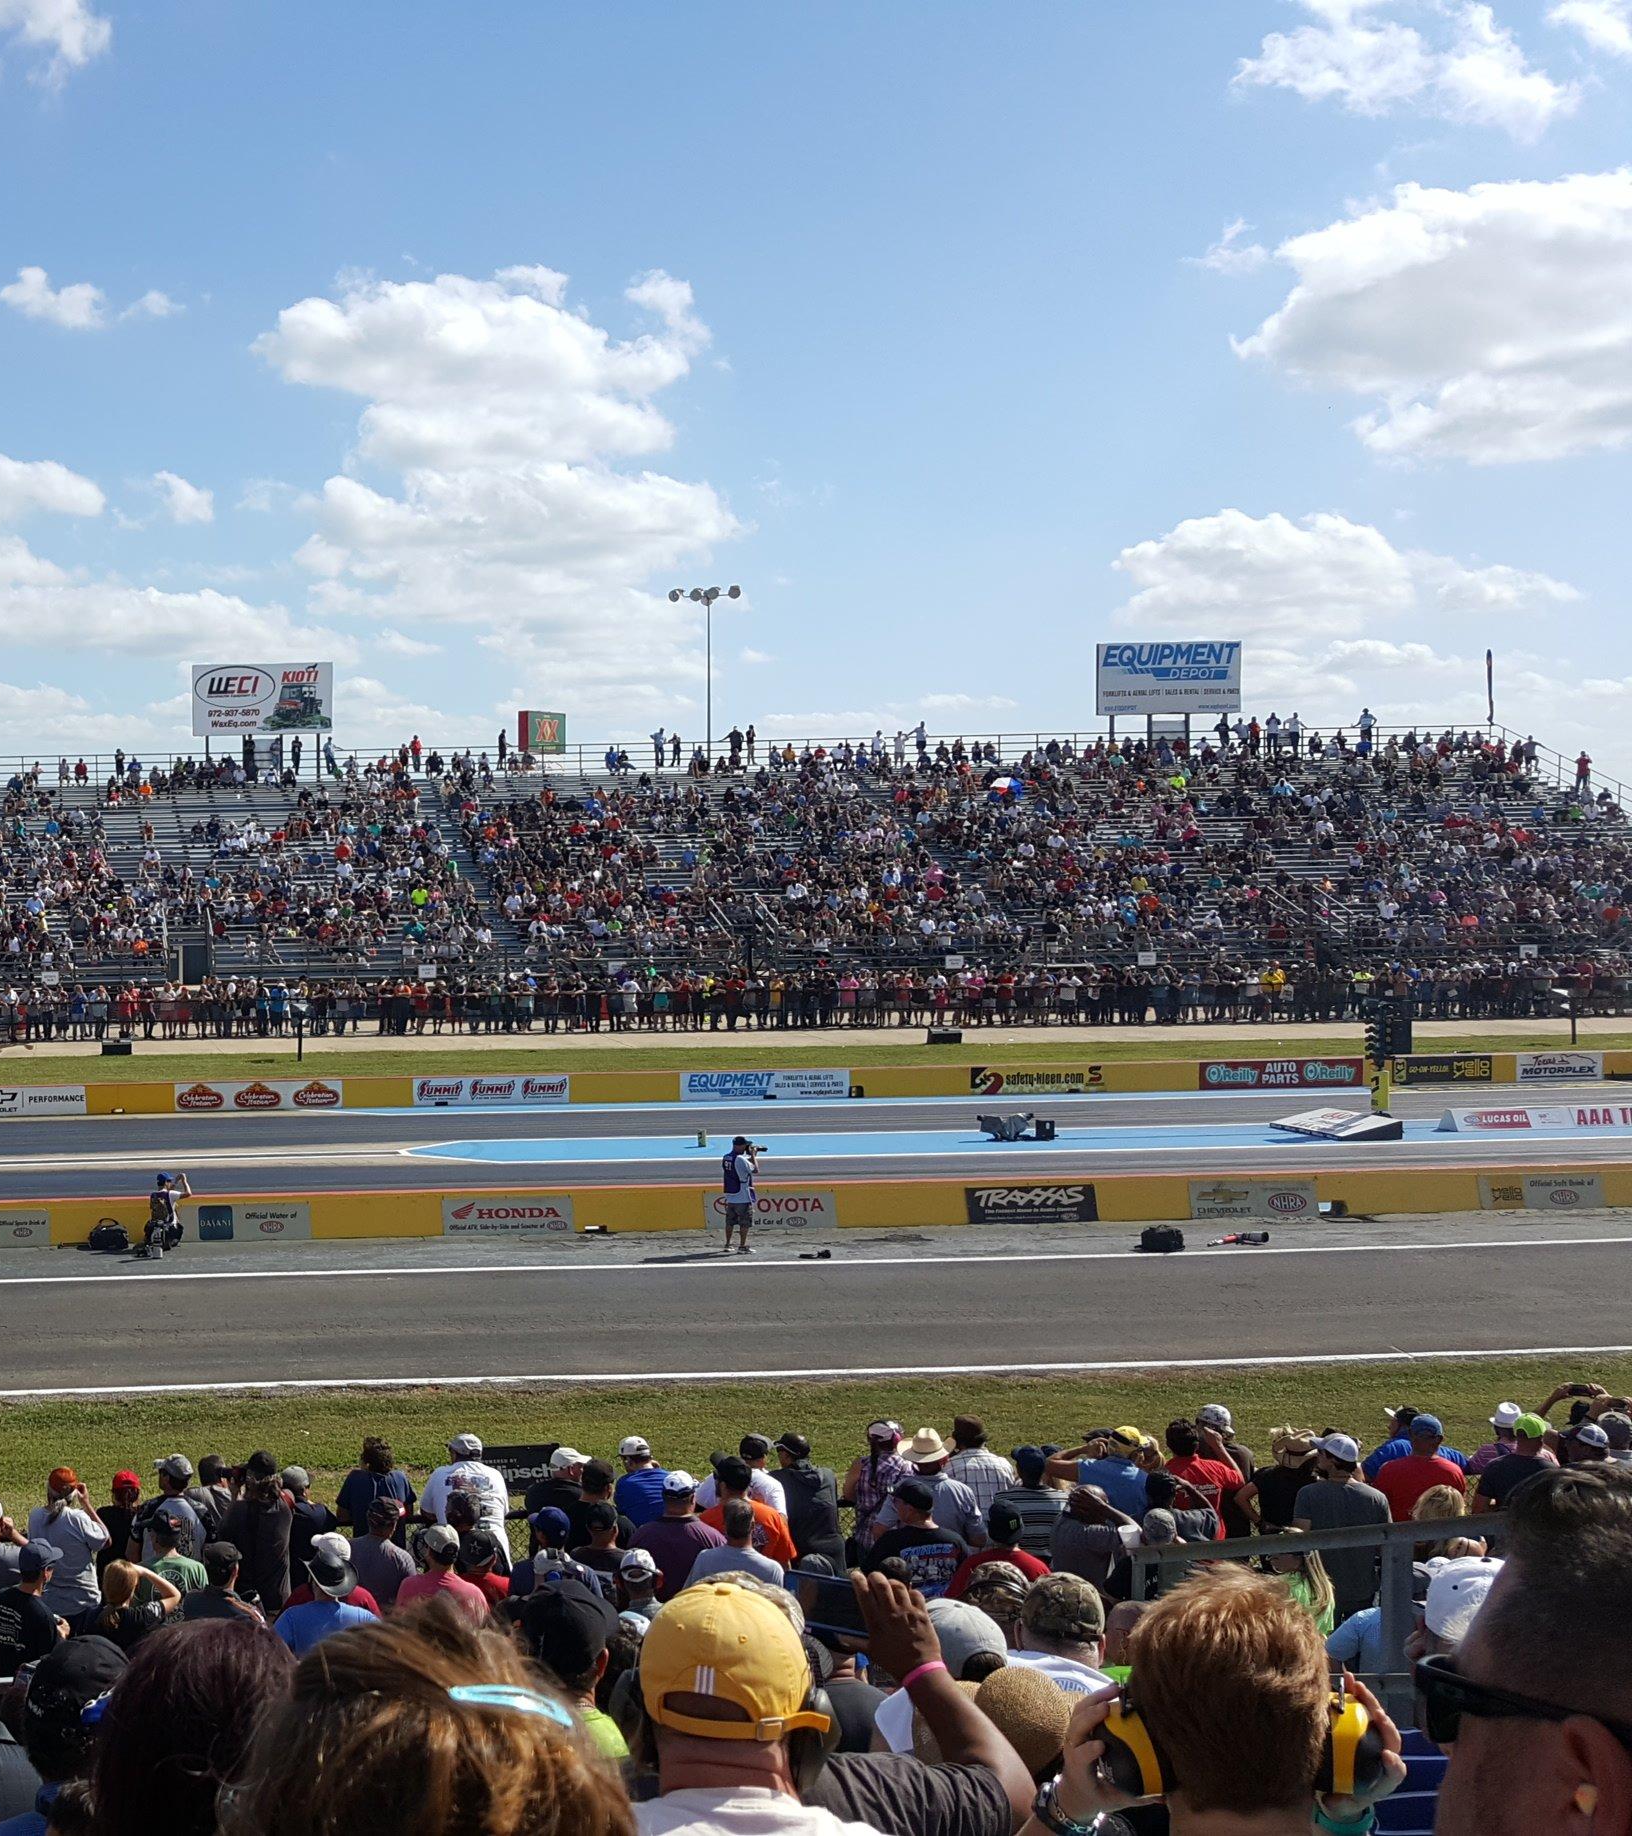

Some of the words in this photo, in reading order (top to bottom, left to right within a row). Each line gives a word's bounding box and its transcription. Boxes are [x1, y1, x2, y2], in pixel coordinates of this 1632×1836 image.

[1102, 643, 1239, 671] EQUIPMENT
[281, 671, 319, 682] KIOTI
[1169, 668, 1215, 679] DEPOT
[207, 676, 259, 695] WECI
[208, 709, 260, 717] 972-937-5870
[211, 720, 257, 728] WaxEq.com
[536, 719, 559, 742] XX
[1265, 1062, 1297, 1072] AUTO
[1533, 1055, 1556, 1067] Texas
[1206, 1064, 1258, 1084] O'Reilly
[1304, 1062, 1355, 1081] O'Reilly
[1522, 1066, 1595, 1075] MOTORPLEX
[688, 1073, 775, 1088] EQUIPMENT
[1006, 1072, 1084, 1086] safety-kleen.com
[1262, 1073, 1299, 1084] PARTS
[28, 1094, 85, 1103] PERFORMANCE
[298, 1091, 333, 1099] Celebration
[1482, 1114, 1511, 1123] LUCAS
[1513, 1113, 1528, 1121] OIL
[1577, 1108, 1614, 1125] AAA
[974, 1187, 1085, 1207] TRAXXAS
[1273, 1196, 1302, 1209] NHRA
[757, 1198, 824, 1212] OYOTA
[1197, 1206, 1253, 1214] CHEVROLET
[476, 1207, 561, 1219] HONDA
[200, 1219, 232, 1227] DASANI
[495, 1464, 553, 1482] lipsch
